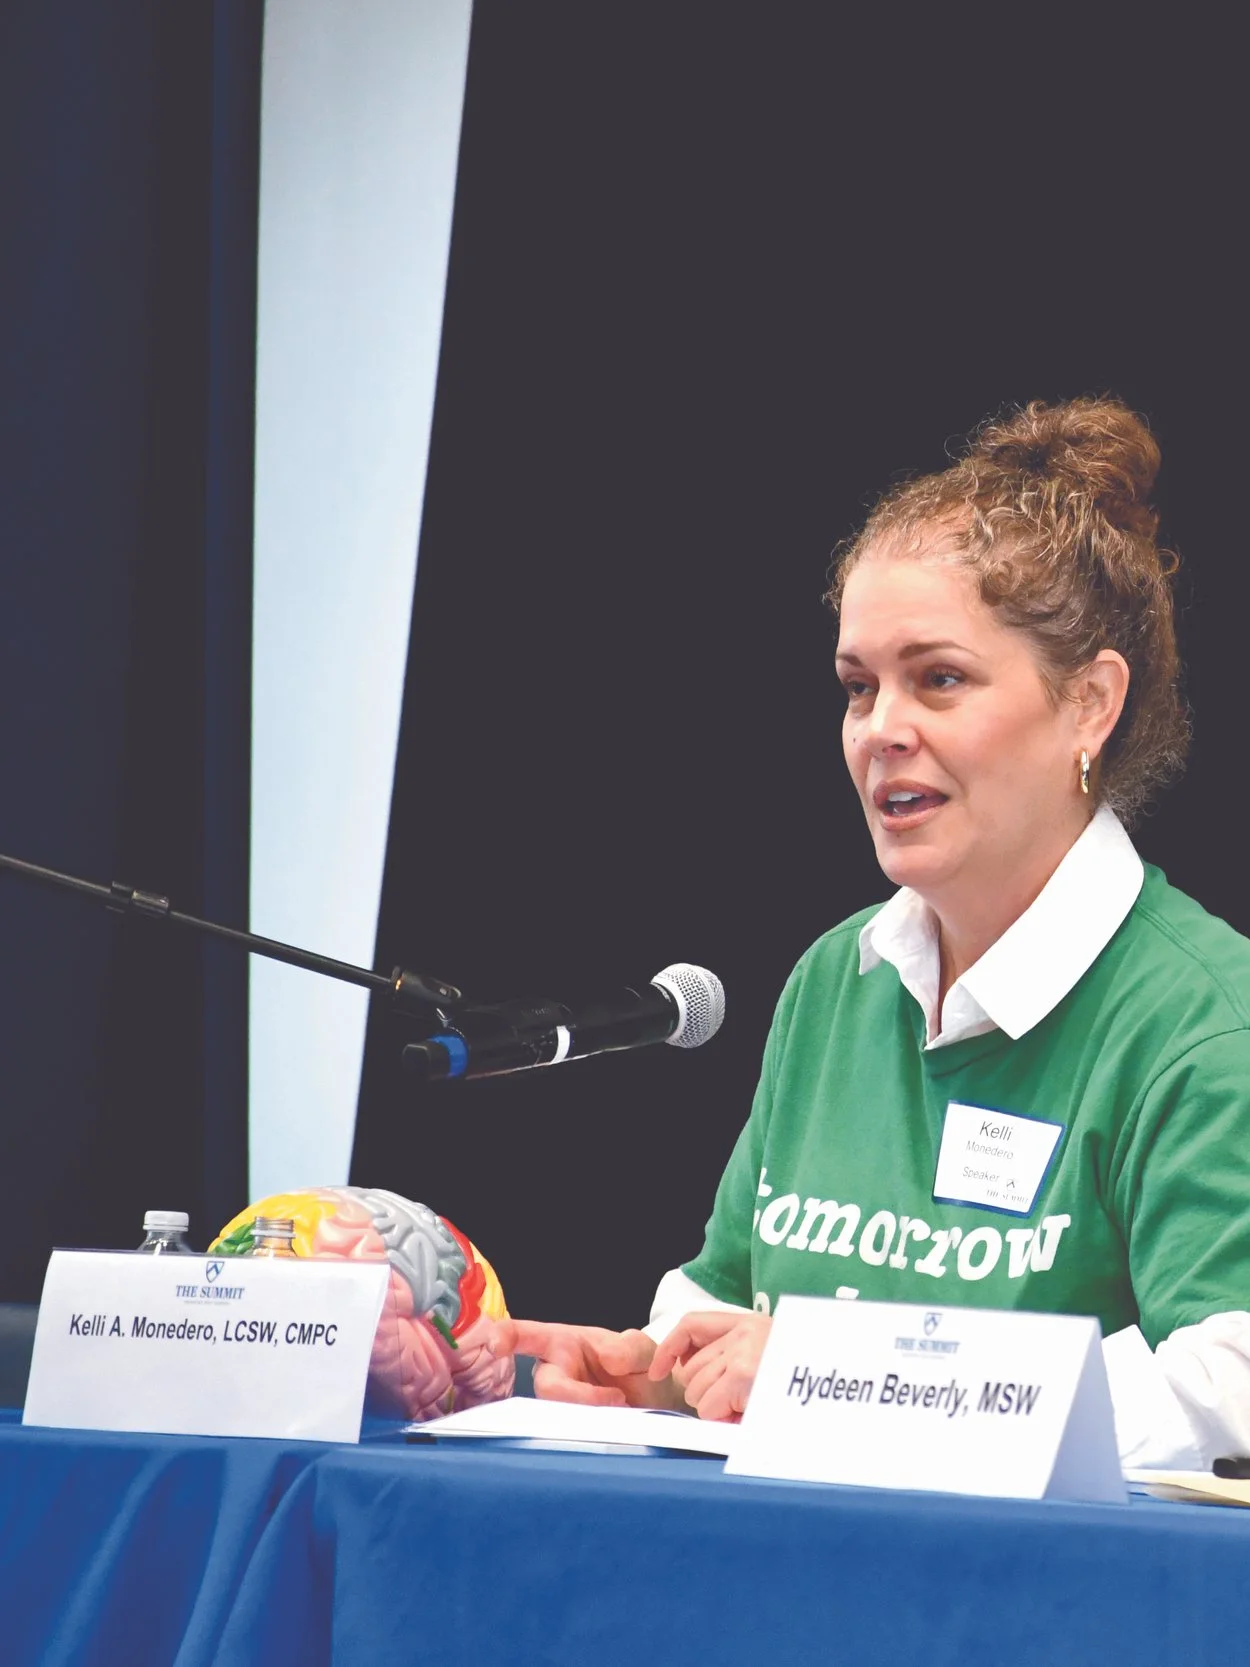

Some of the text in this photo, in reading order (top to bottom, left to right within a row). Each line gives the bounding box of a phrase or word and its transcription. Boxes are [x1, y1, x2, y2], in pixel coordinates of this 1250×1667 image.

[979, 1120, 1014, 1141] Kelli
[965, 1140, 1014, 1160] Monedero
[962, 1166, 1000, 1183] Speaker
[176, 1285, 245, 1300] THE SUMMIT
[69, 1314, 338, 1347] Kelli A. Monedero, LCSW, CMPC
[787, 1366, 1042, 1418] Hydeen Beverly, MSW
